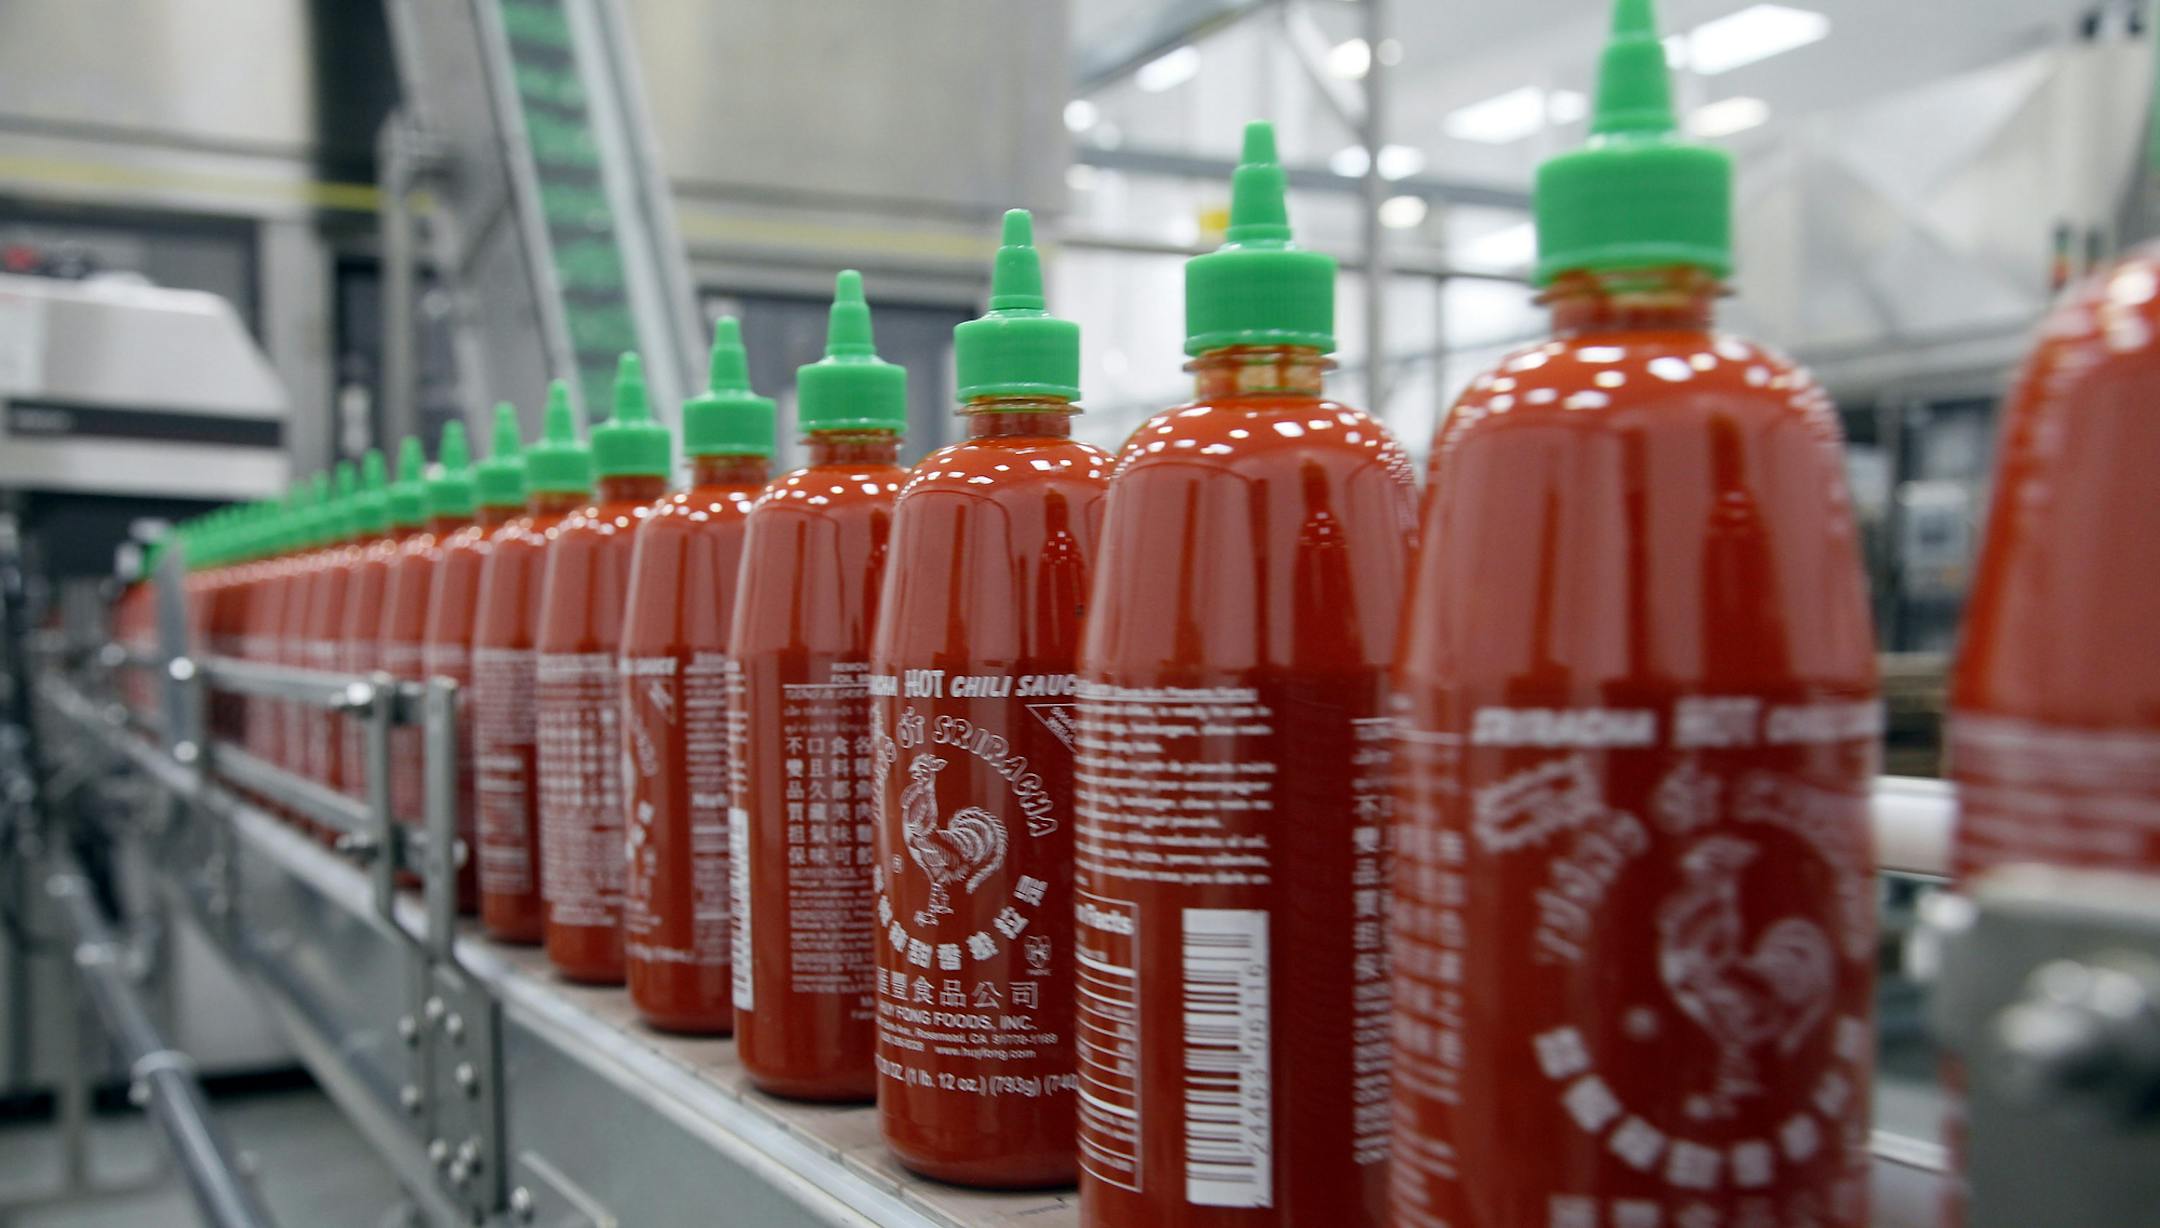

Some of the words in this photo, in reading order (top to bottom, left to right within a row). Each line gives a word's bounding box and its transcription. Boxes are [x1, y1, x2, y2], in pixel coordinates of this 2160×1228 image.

[904, 669, 945, 698] HOT
[950, 675, 1012, 698] CHILI
[1015, 674, 1078, 697] SAUC
[932, 715, 1058, 838] SRIRACHA
[934, 1045, 1037, 1061] www.huyfong.com
[937, 1072, 957, 1090] 12
[989, 1074, 1041, 1098] (793g)
[1043, 1072, 1079, 1097] (740
